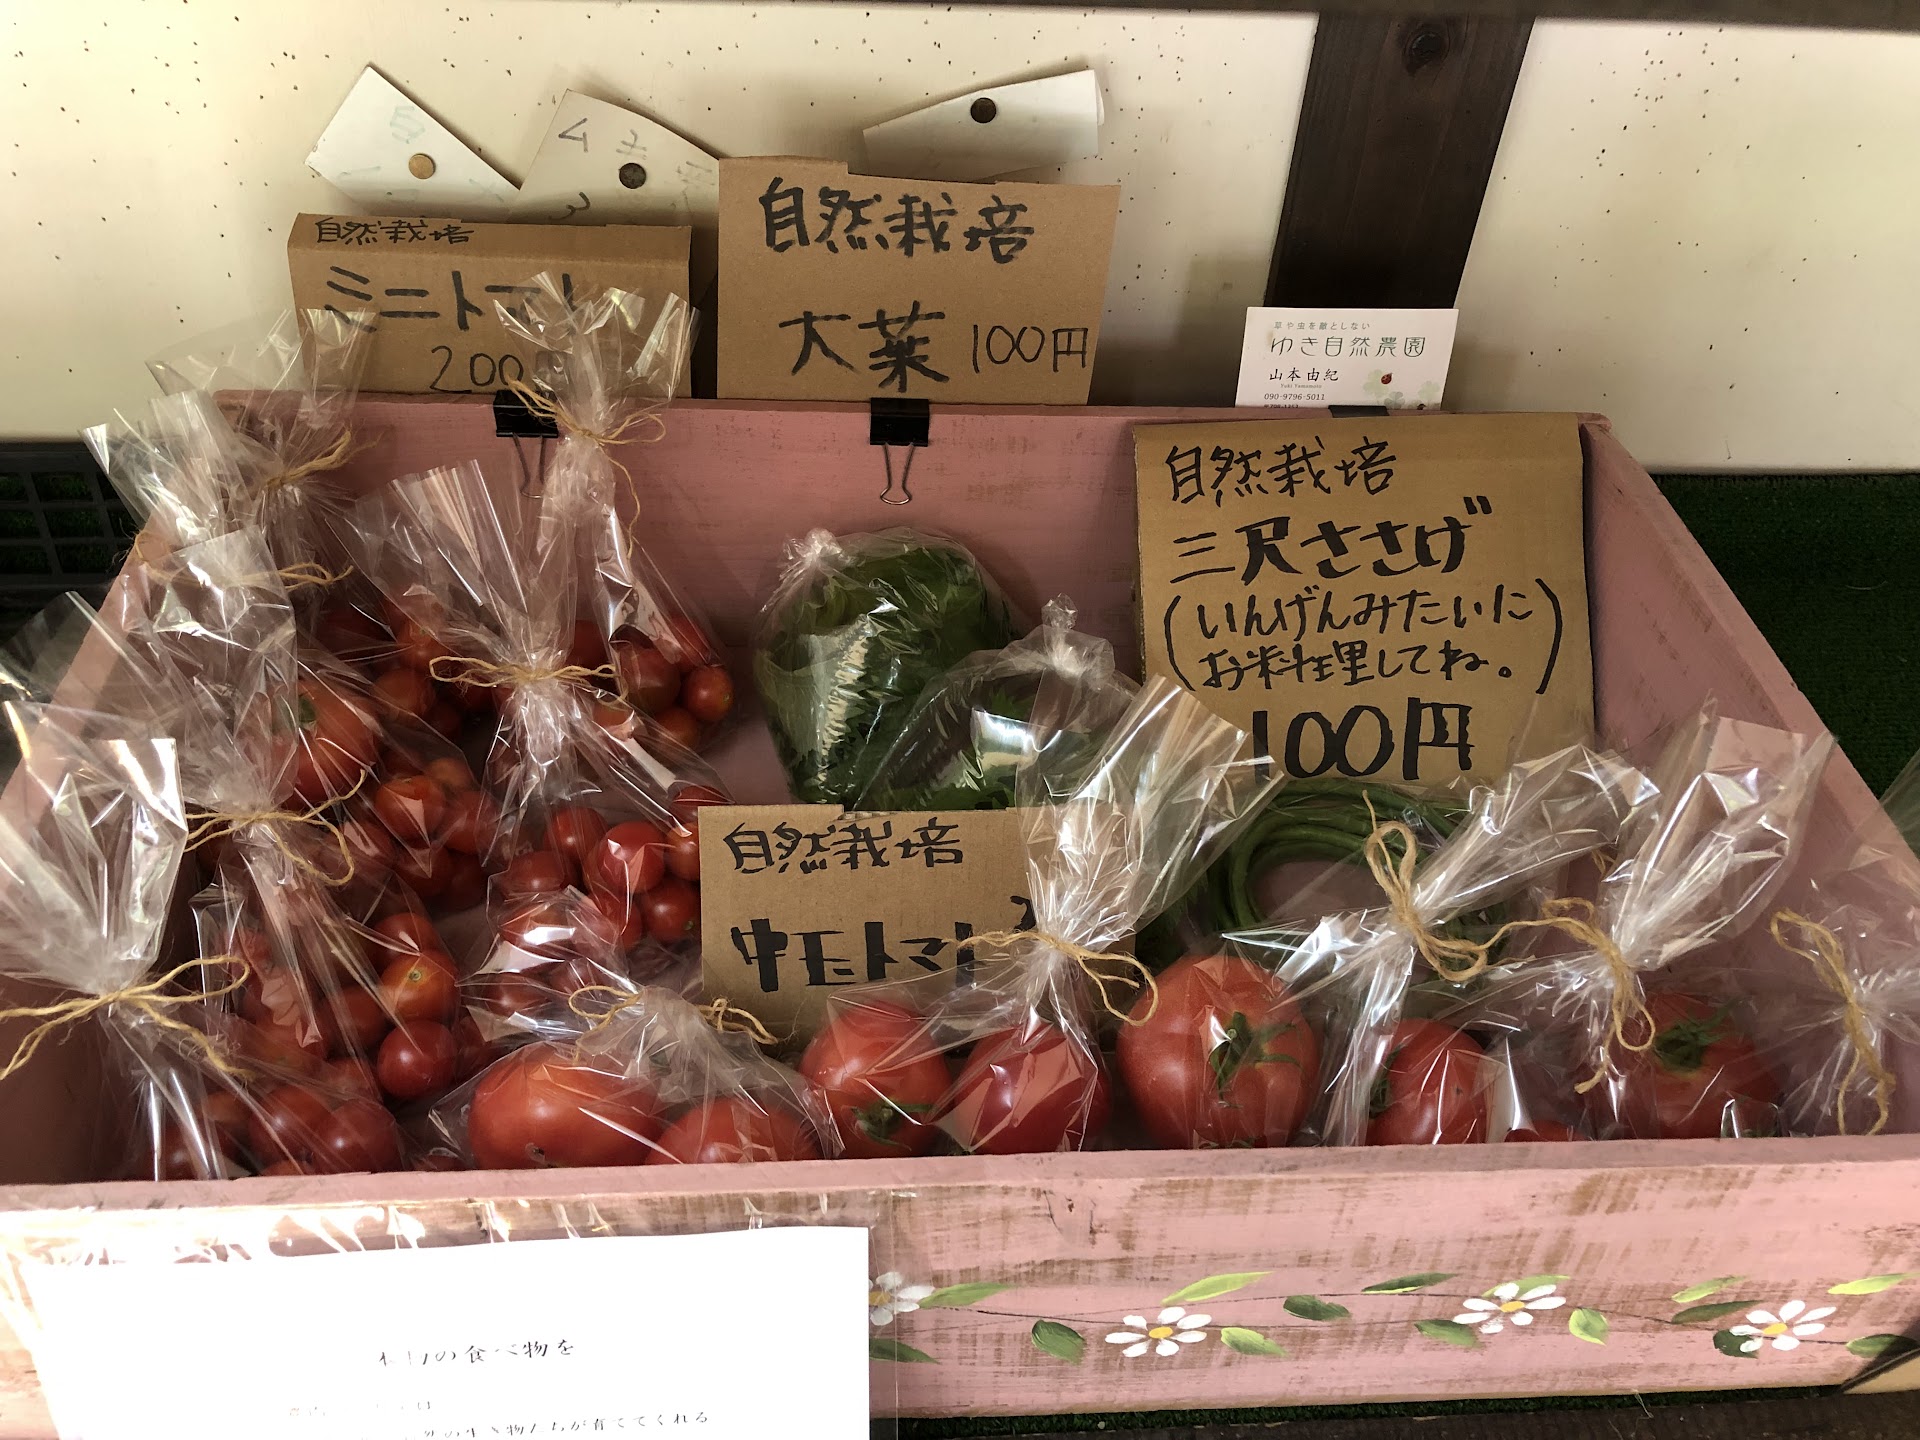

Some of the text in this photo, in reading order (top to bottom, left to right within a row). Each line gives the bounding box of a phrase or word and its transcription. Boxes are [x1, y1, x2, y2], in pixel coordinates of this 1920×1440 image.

[315, 216, 475, 246] 自然栽培
[758, 175, 1035, 264] 自然栽培
[971, 322, 1090, 374] 100円
[1270, 336, 1426, 357] ゆき自然農園
[1273, 321, 1371, 330] 草や虫を敵としない
[1269, 367, 1339, 382] 山本由紀
[1164, 435, 1397, 507] 自然栽培
[1170, 495, 1493, 586] 三尺ささげ
[1252, 697, 1475, 784] 100円
[722, 816, 964, 875] 自然栽培
